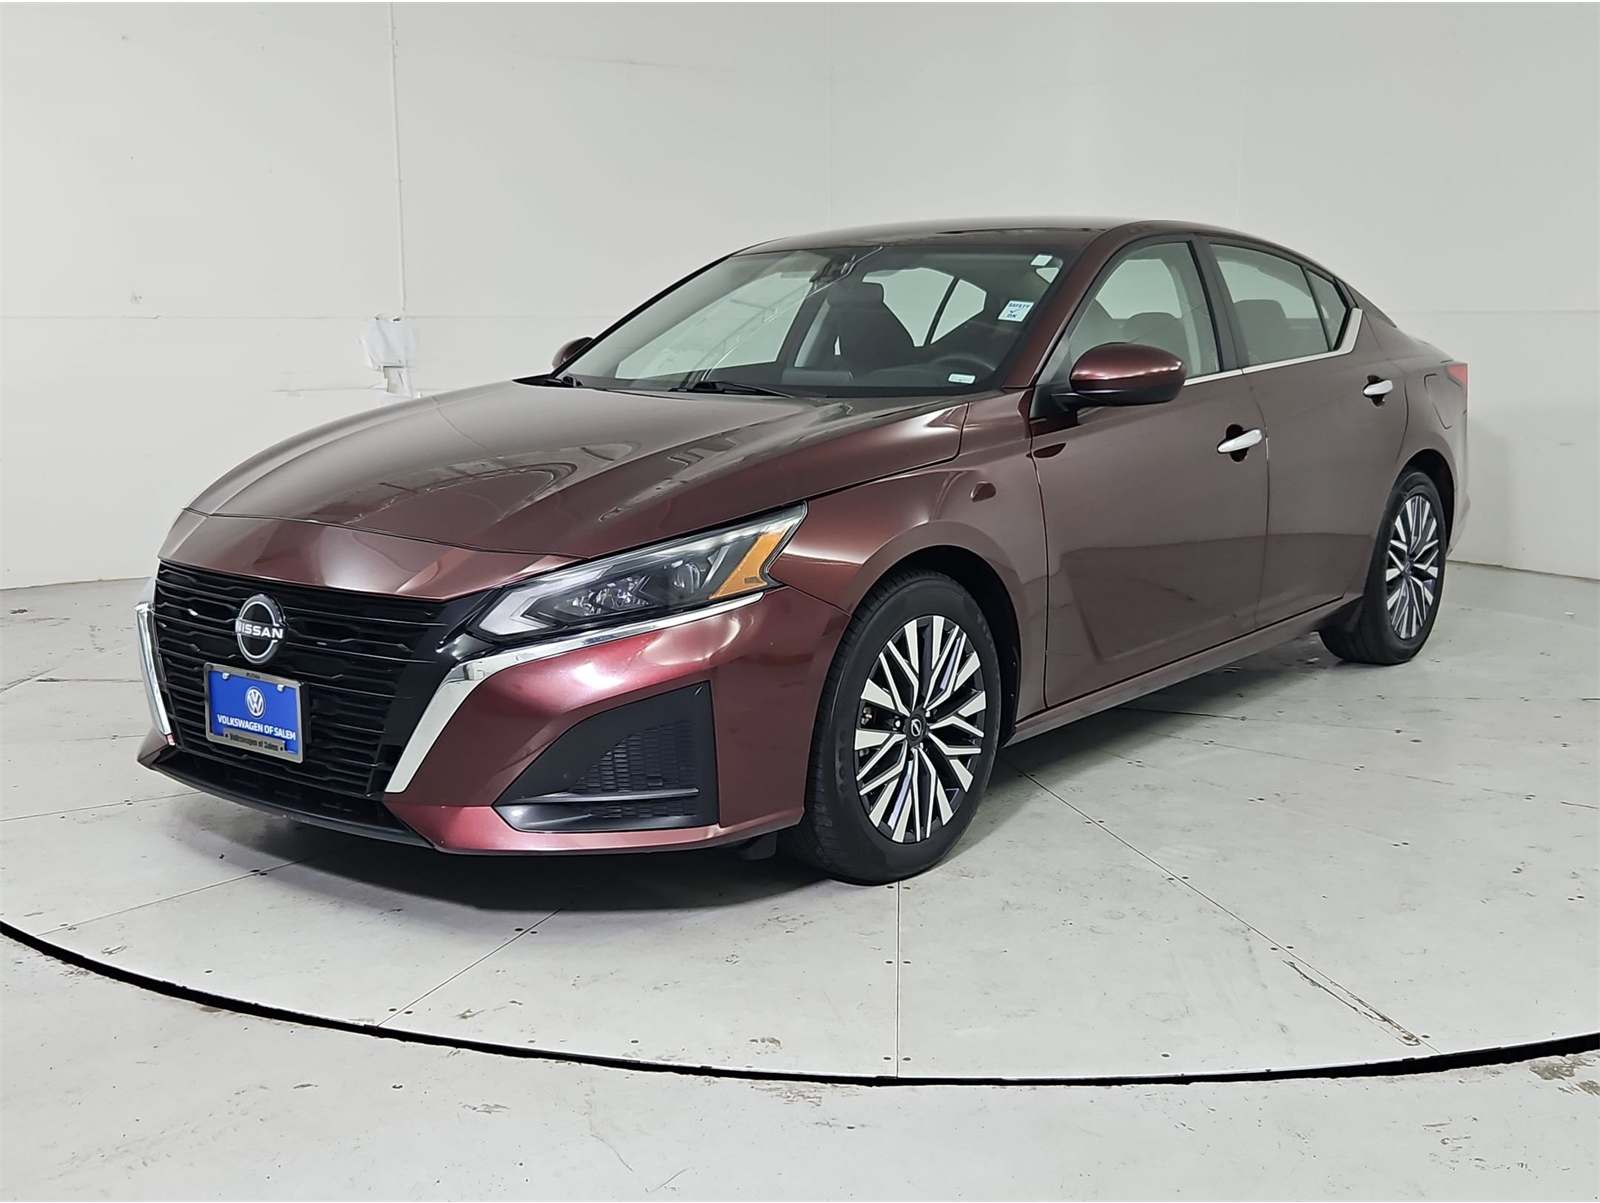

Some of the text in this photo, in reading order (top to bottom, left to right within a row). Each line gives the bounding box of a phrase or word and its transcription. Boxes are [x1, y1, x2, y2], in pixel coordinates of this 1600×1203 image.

[235, 619, 284, 639] NISSAN
[217, 713, 296, 741] VOLKSWAGEN OF SALEM
